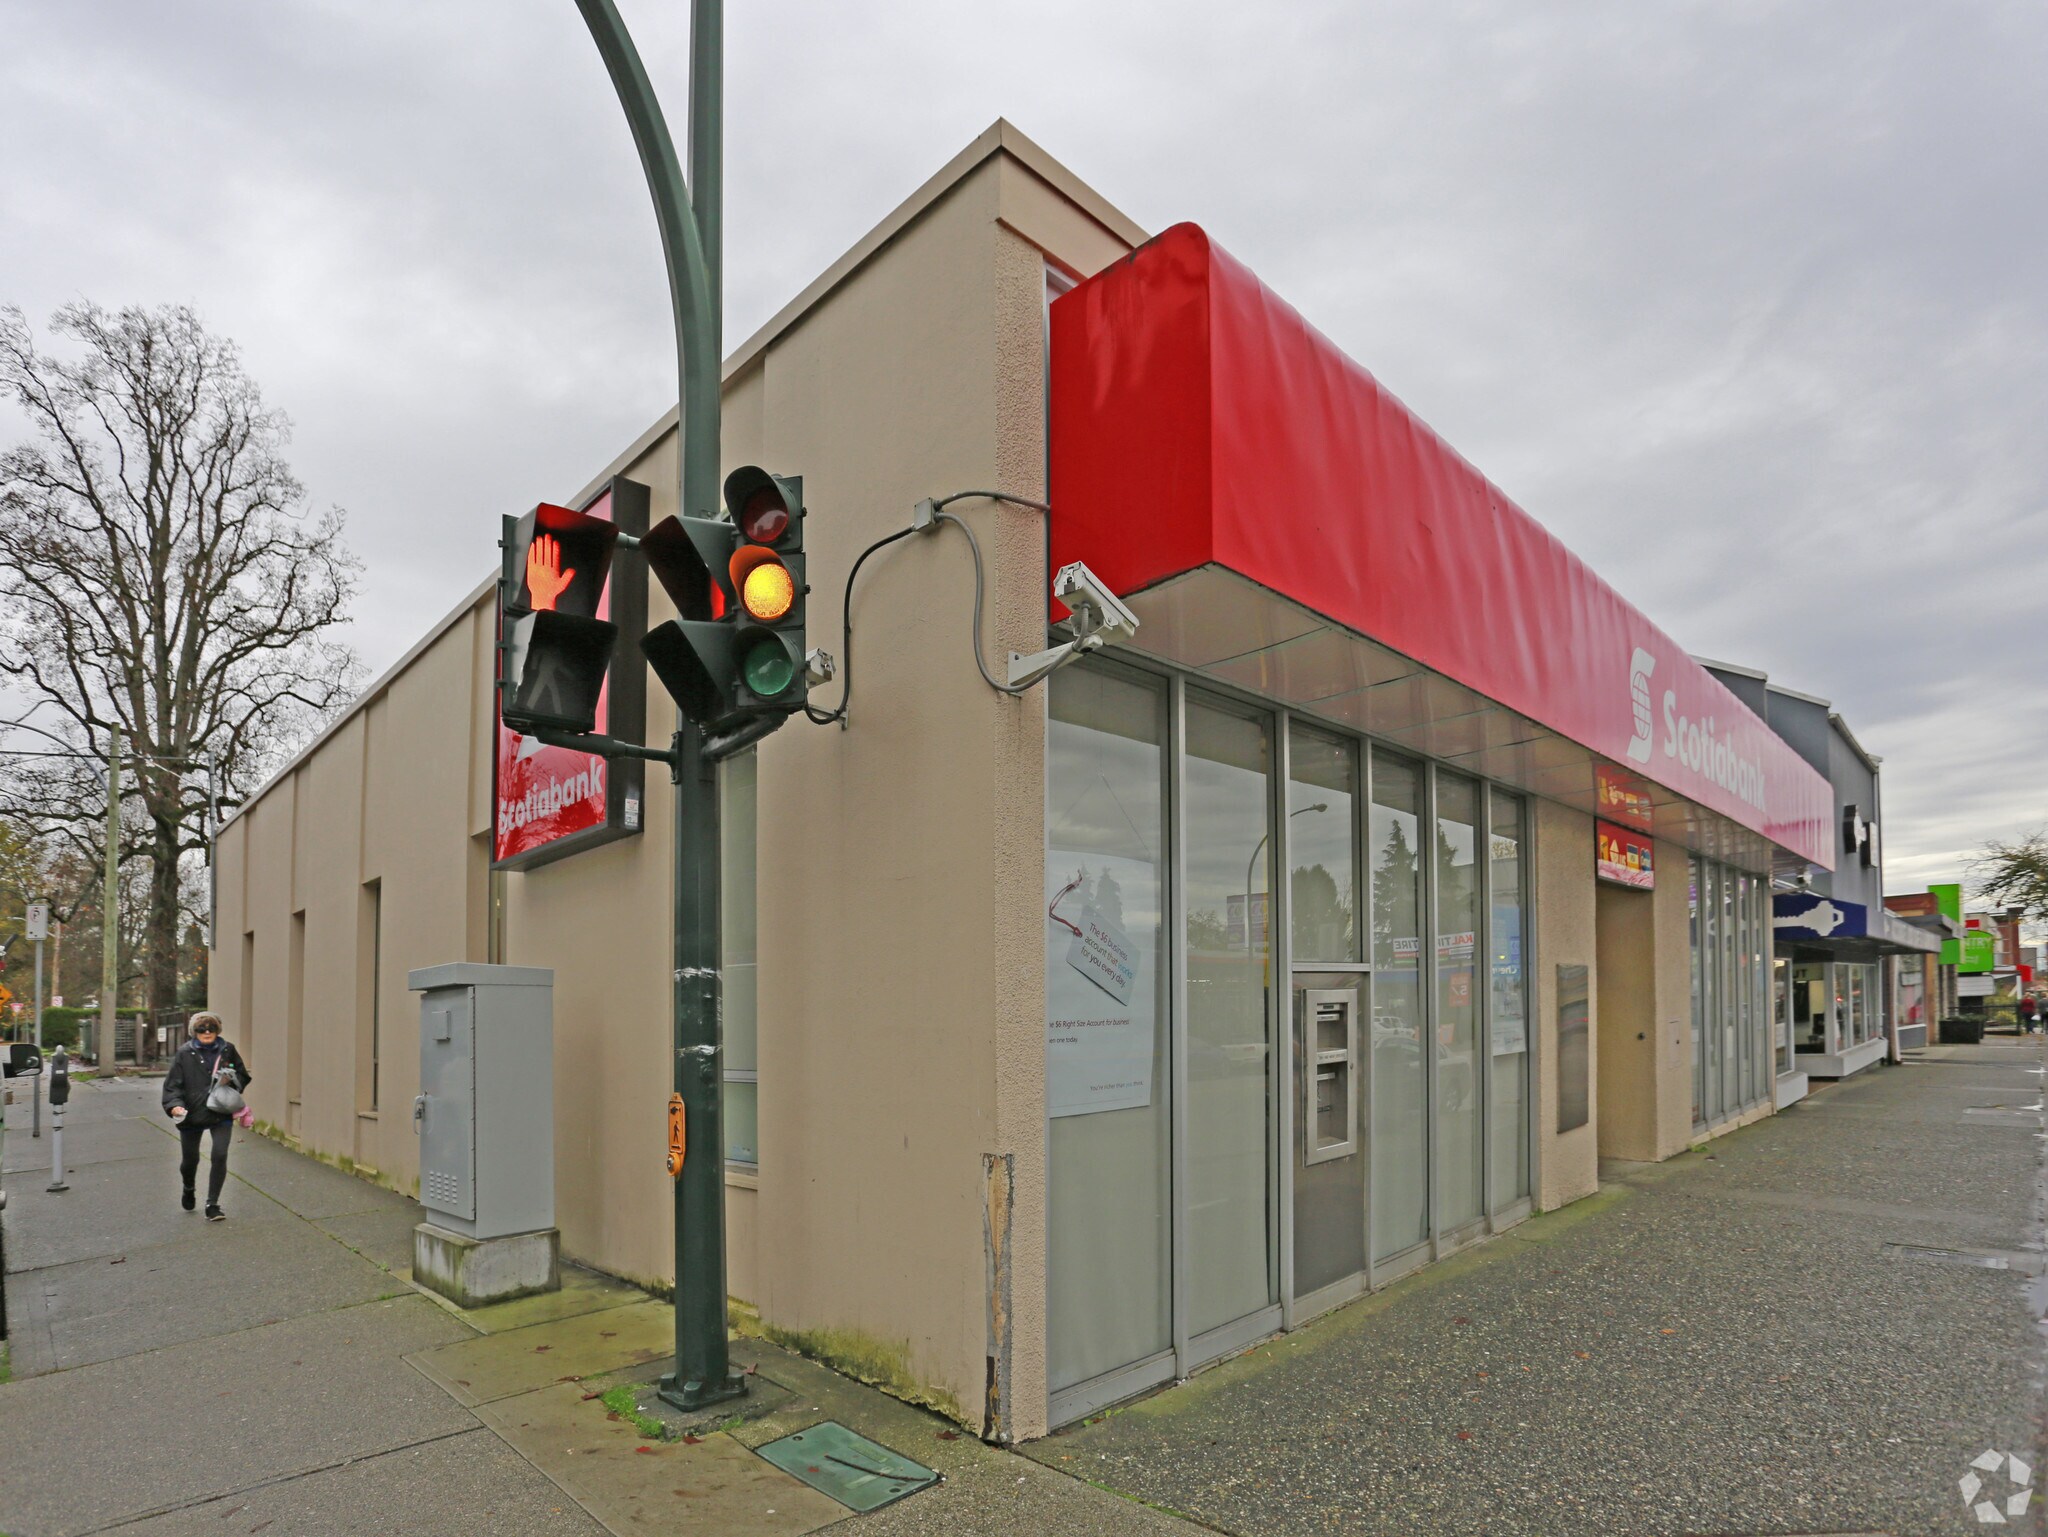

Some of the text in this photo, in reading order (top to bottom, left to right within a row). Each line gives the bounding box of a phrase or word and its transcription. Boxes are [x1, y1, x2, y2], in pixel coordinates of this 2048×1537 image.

[1663, 689, 1767, 814] Scotiabank
[498, 757, 603, 834] Scotiabank
[1084, 936, 1107, 958] account
[1106, 952, 1119, 966] that
[1089, 922, 1128, 961] The $6 business
[1080, 946, 1090, 958] for
[1089, 953, 1102, 968] you
[1101, 963, 1117, 981] every
[1062, 1020, 1076, 1030] Right
[1086, 1019, 1105, 1028] Account
